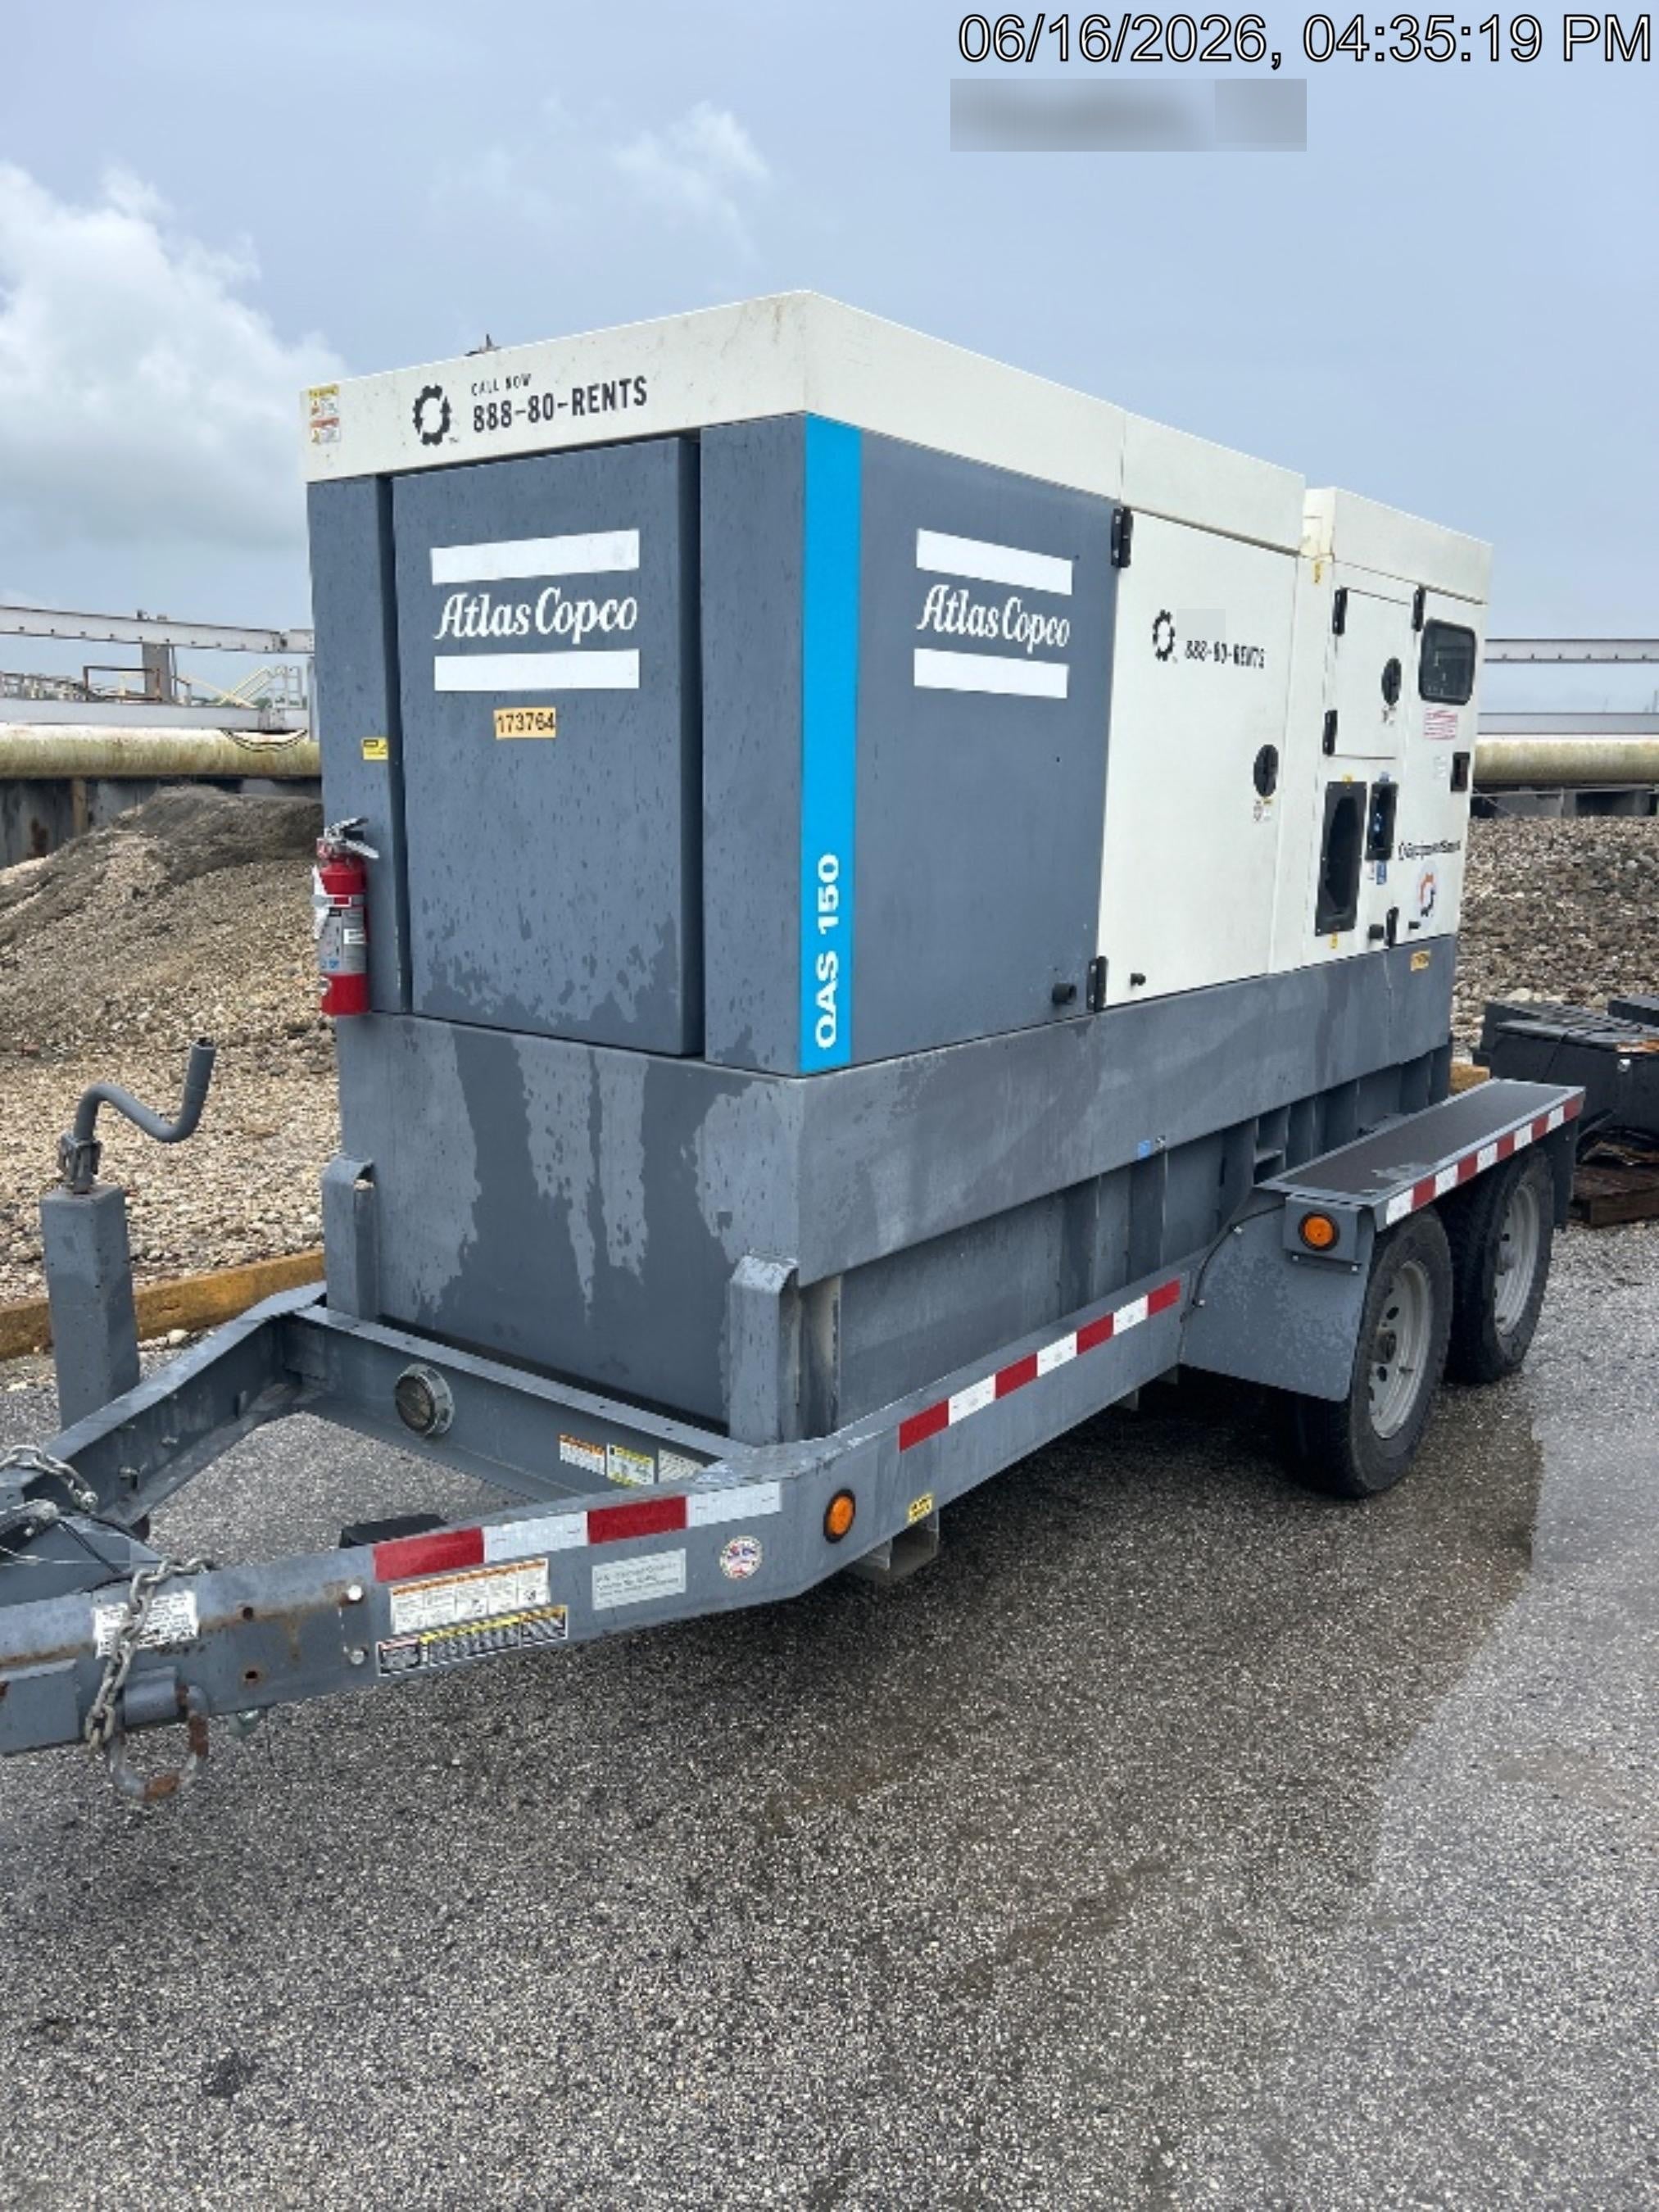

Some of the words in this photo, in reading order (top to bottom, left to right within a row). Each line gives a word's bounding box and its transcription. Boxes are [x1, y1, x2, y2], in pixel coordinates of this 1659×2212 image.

[471, 378, 499, 396] CALL
[505, 373, 531, 390] NOW
[473, 375, 647, 433] 888-80-RENTS
[433, 592, 532, 640] Atlas
[535, 587, 637, 644] Copco
[916, 584, 999, 638] Atlas
[1002, 596, 1070, 654] Copco
[498, 712, 556, 733] 173764
[818, 854, 840, 935] 150
[815, 950, 839, 1049] QAS
